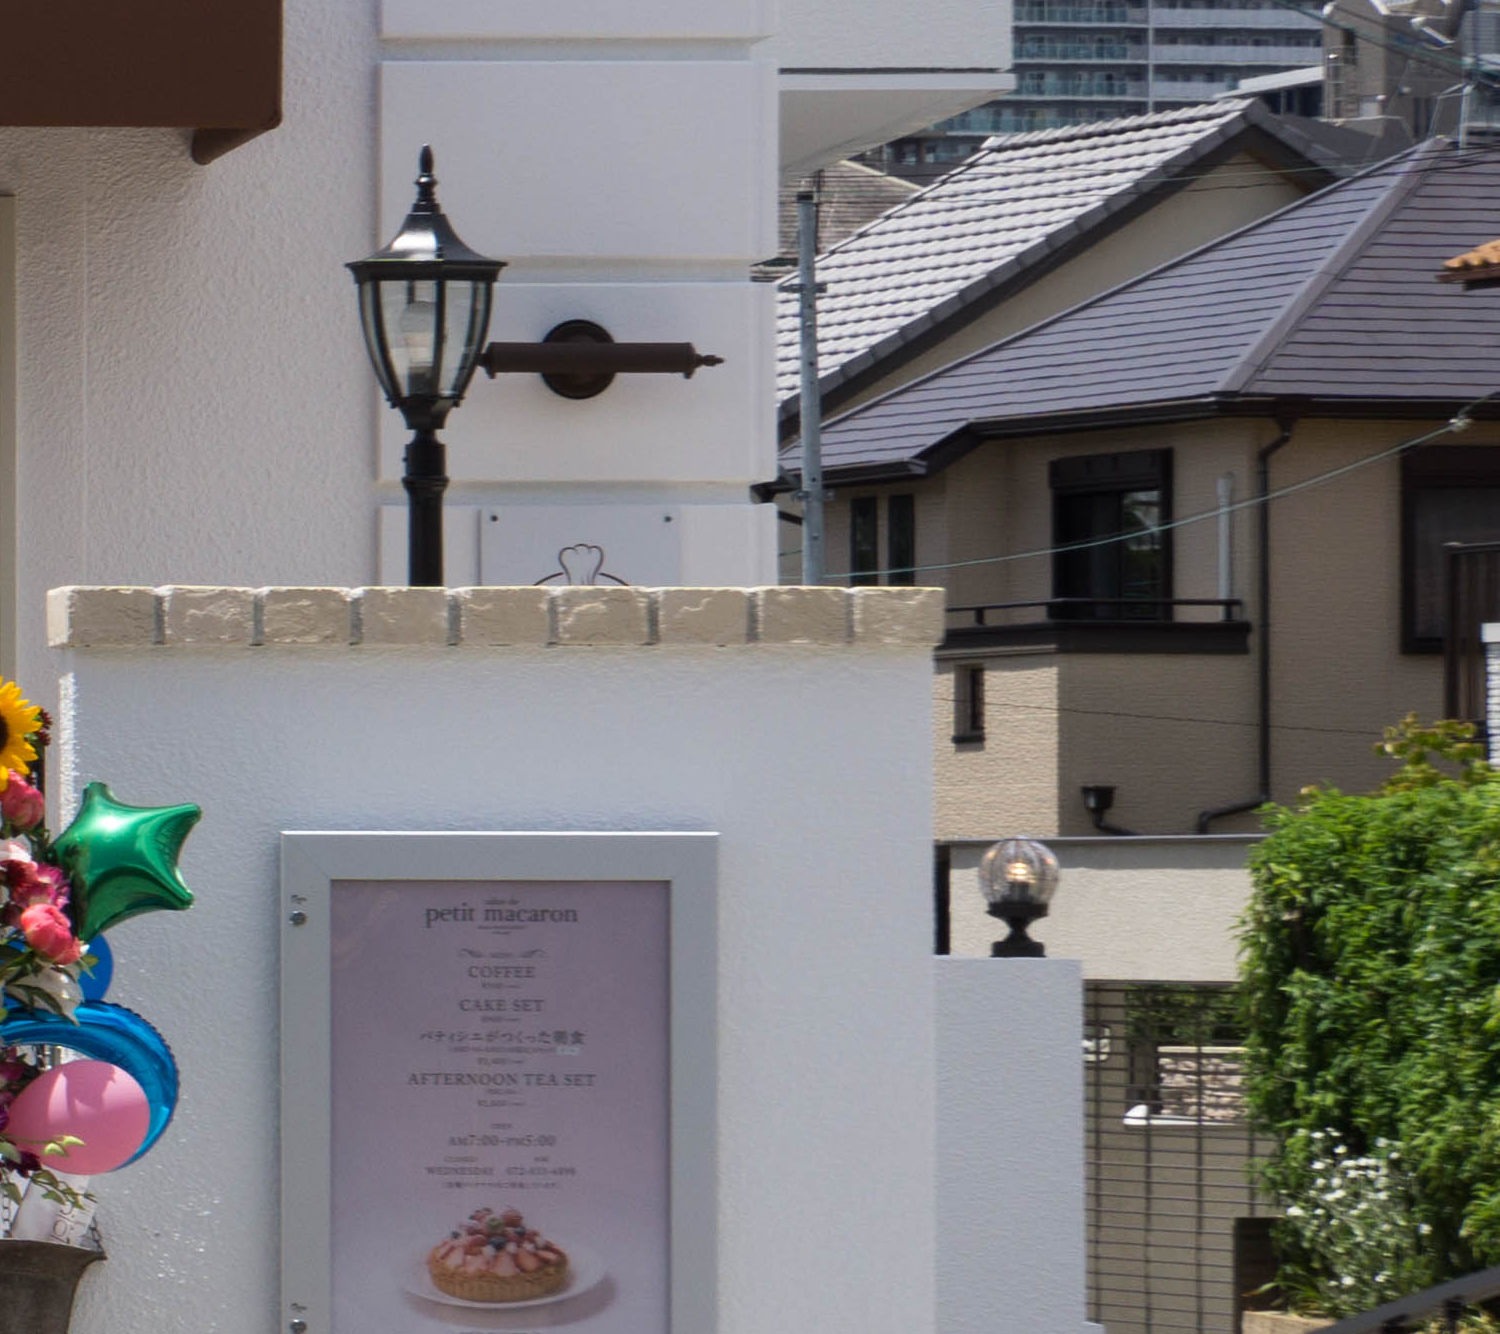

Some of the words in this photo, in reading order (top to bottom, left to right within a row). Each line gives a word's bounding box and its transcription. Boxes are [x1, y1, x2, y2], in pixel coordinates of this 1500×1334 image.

[424, 902, 476, 929] petit
[483, 907, 580, 923] macaron
[467, 965, 537, 979] COFFEE
[458, 998, 508, 1012] CAKE
[511, 999, 546, 1012] SET
[407, 1072, 520, 1086] AFTERNOON
[523, 1072, 560, 1087] TEA
[562, 1073, 598, 1087] SET
